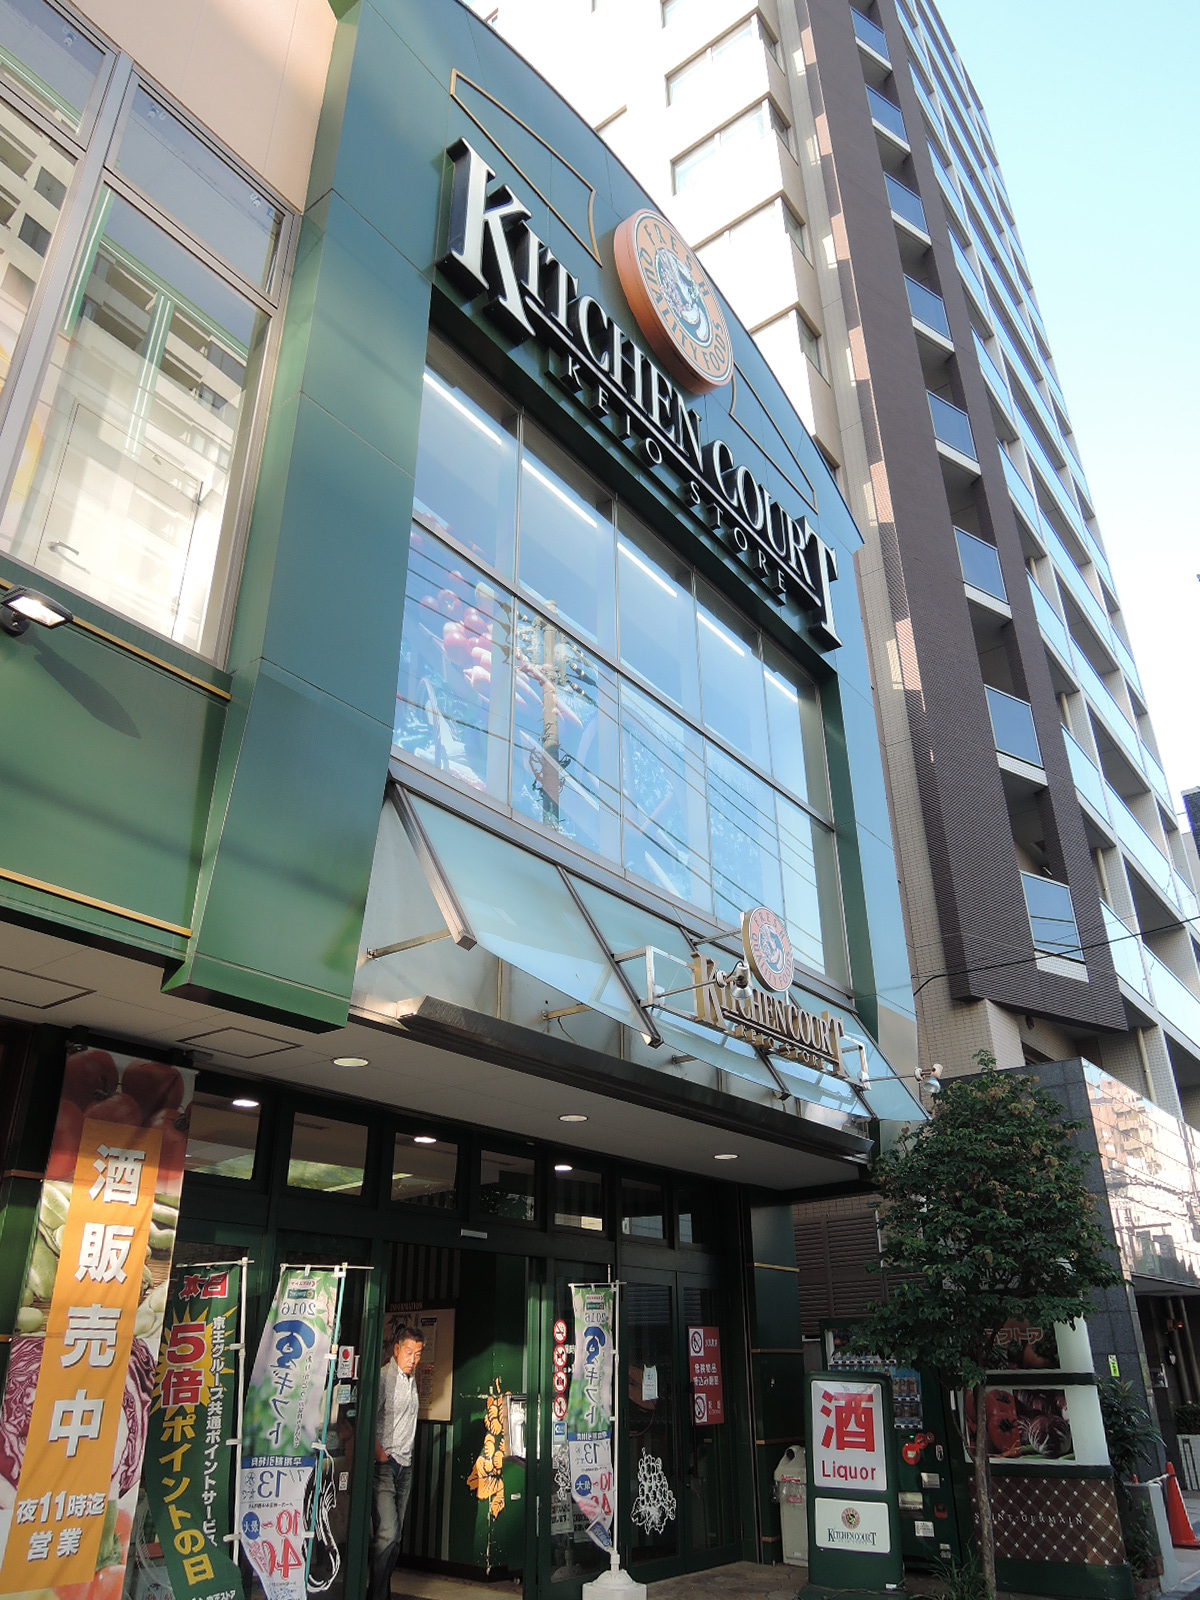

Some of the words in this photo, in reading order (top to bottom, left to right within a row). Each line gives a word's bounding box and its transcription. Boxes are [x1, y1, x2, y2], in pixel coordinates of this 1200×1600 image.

[643, 223, 709, 297] FRESH
[639, 246, 699, 362] QUALITY
[702, 319, 728, 373] FOODS
[440, 138, 706, 473] KITCHEN
[702, 438, 843, 653] COURT
[561, 354, 663, 467] KEIO
[684, 480, 788, 595] STORE
[753, 911, 786, 940] FRESH
[751, 932, 778, 987] QUALITY
[777, 951, 792, 988] FOODS
[737, 1025, 776, 1050] KEIO
[780, 1043, 829, 1073] STORE
[47, 1143, 147, 1458] 酒販売中
[178, 1270, 230, 1301] 本日
[820, 1390, 875, 1452] 酒
[821, 1460, 877, 1481] Liquor
[16, 1490, 107, 1525] 夜11時迄
[974, 1511, 1083, 1525] SINT-GERMAIN
[26, 1527, 83, 1563] 営業
